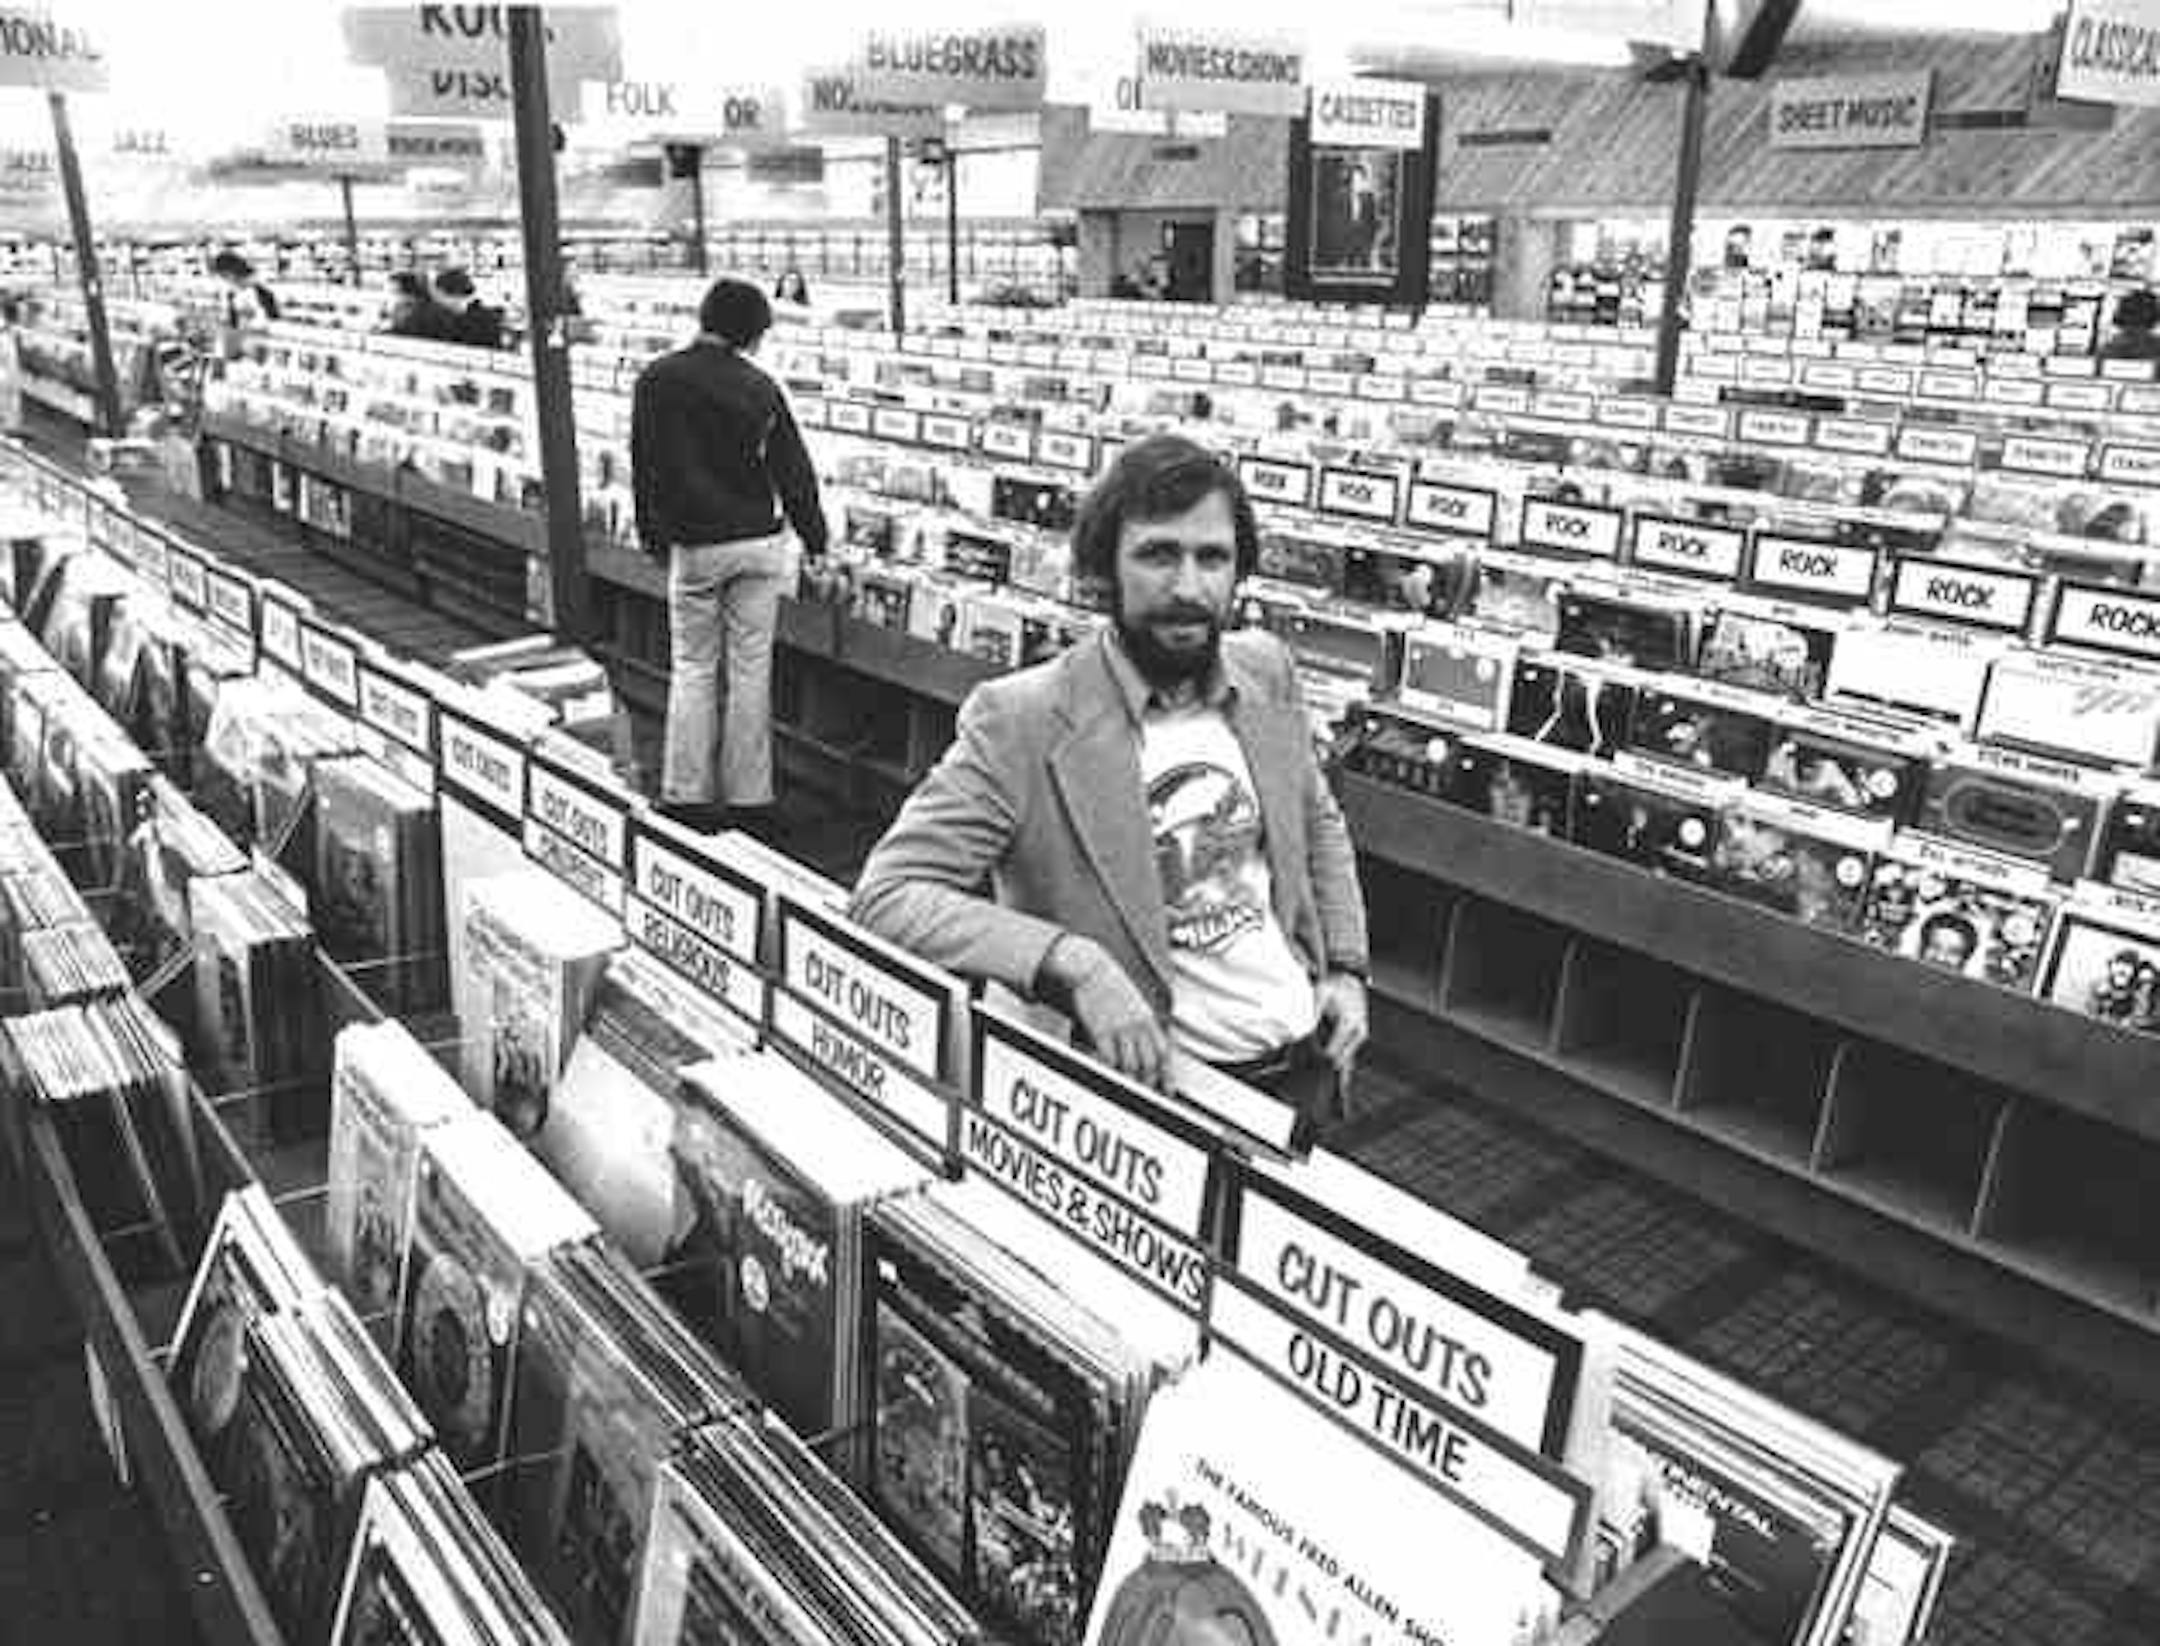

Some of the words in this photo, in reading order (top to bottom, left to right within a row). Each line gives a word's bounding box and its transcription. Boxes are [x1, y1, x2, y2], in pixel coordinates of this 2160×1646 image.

[868, 30, 1038, 79] BLUEGRASS
[603, 80, 677, 117] FOLK
[1777, 101, 1841, 133] SHEET
[1847, 96, 1918, 128] MUSIC
[1545, 511, 1592, 538] ROCK
[1657, 530, 1708, 559] ROCK
[1779, 547, 1838, 579] ROCK
[1926, 576, 1996, 610] ROCK
[2087, 602, 2160, 636] ROCK
[650, 861, 682, 909] CUT
[686, 883, 735, 942] OUTS
[644, 912, 731, 992] RELIGIOUS
[806, 949, 845, 1005] CUT
[850, 980, 910, 1049] OUTS
[1011, 1076, 1070, 1144] CUT
[1075, 1117, 1163, 1204] OUTS
[970, 1120, 1063, 1211] MOVIES
[1066, 1185, 1090, 1224] &
[1093, 1202, 1206, 1301] SHOWS
[1278, 1242, 1362, 1325] CUT
[1368, 1296, 1491, 1408] OUTS
[1288, 1333, 1361, 1408] OLD
[1371, 1383, 1469, 1482] TIME
[1299, 1537, 1339, 1578] FRED
[1343, 1573, 1399, 1623] ALLEN
